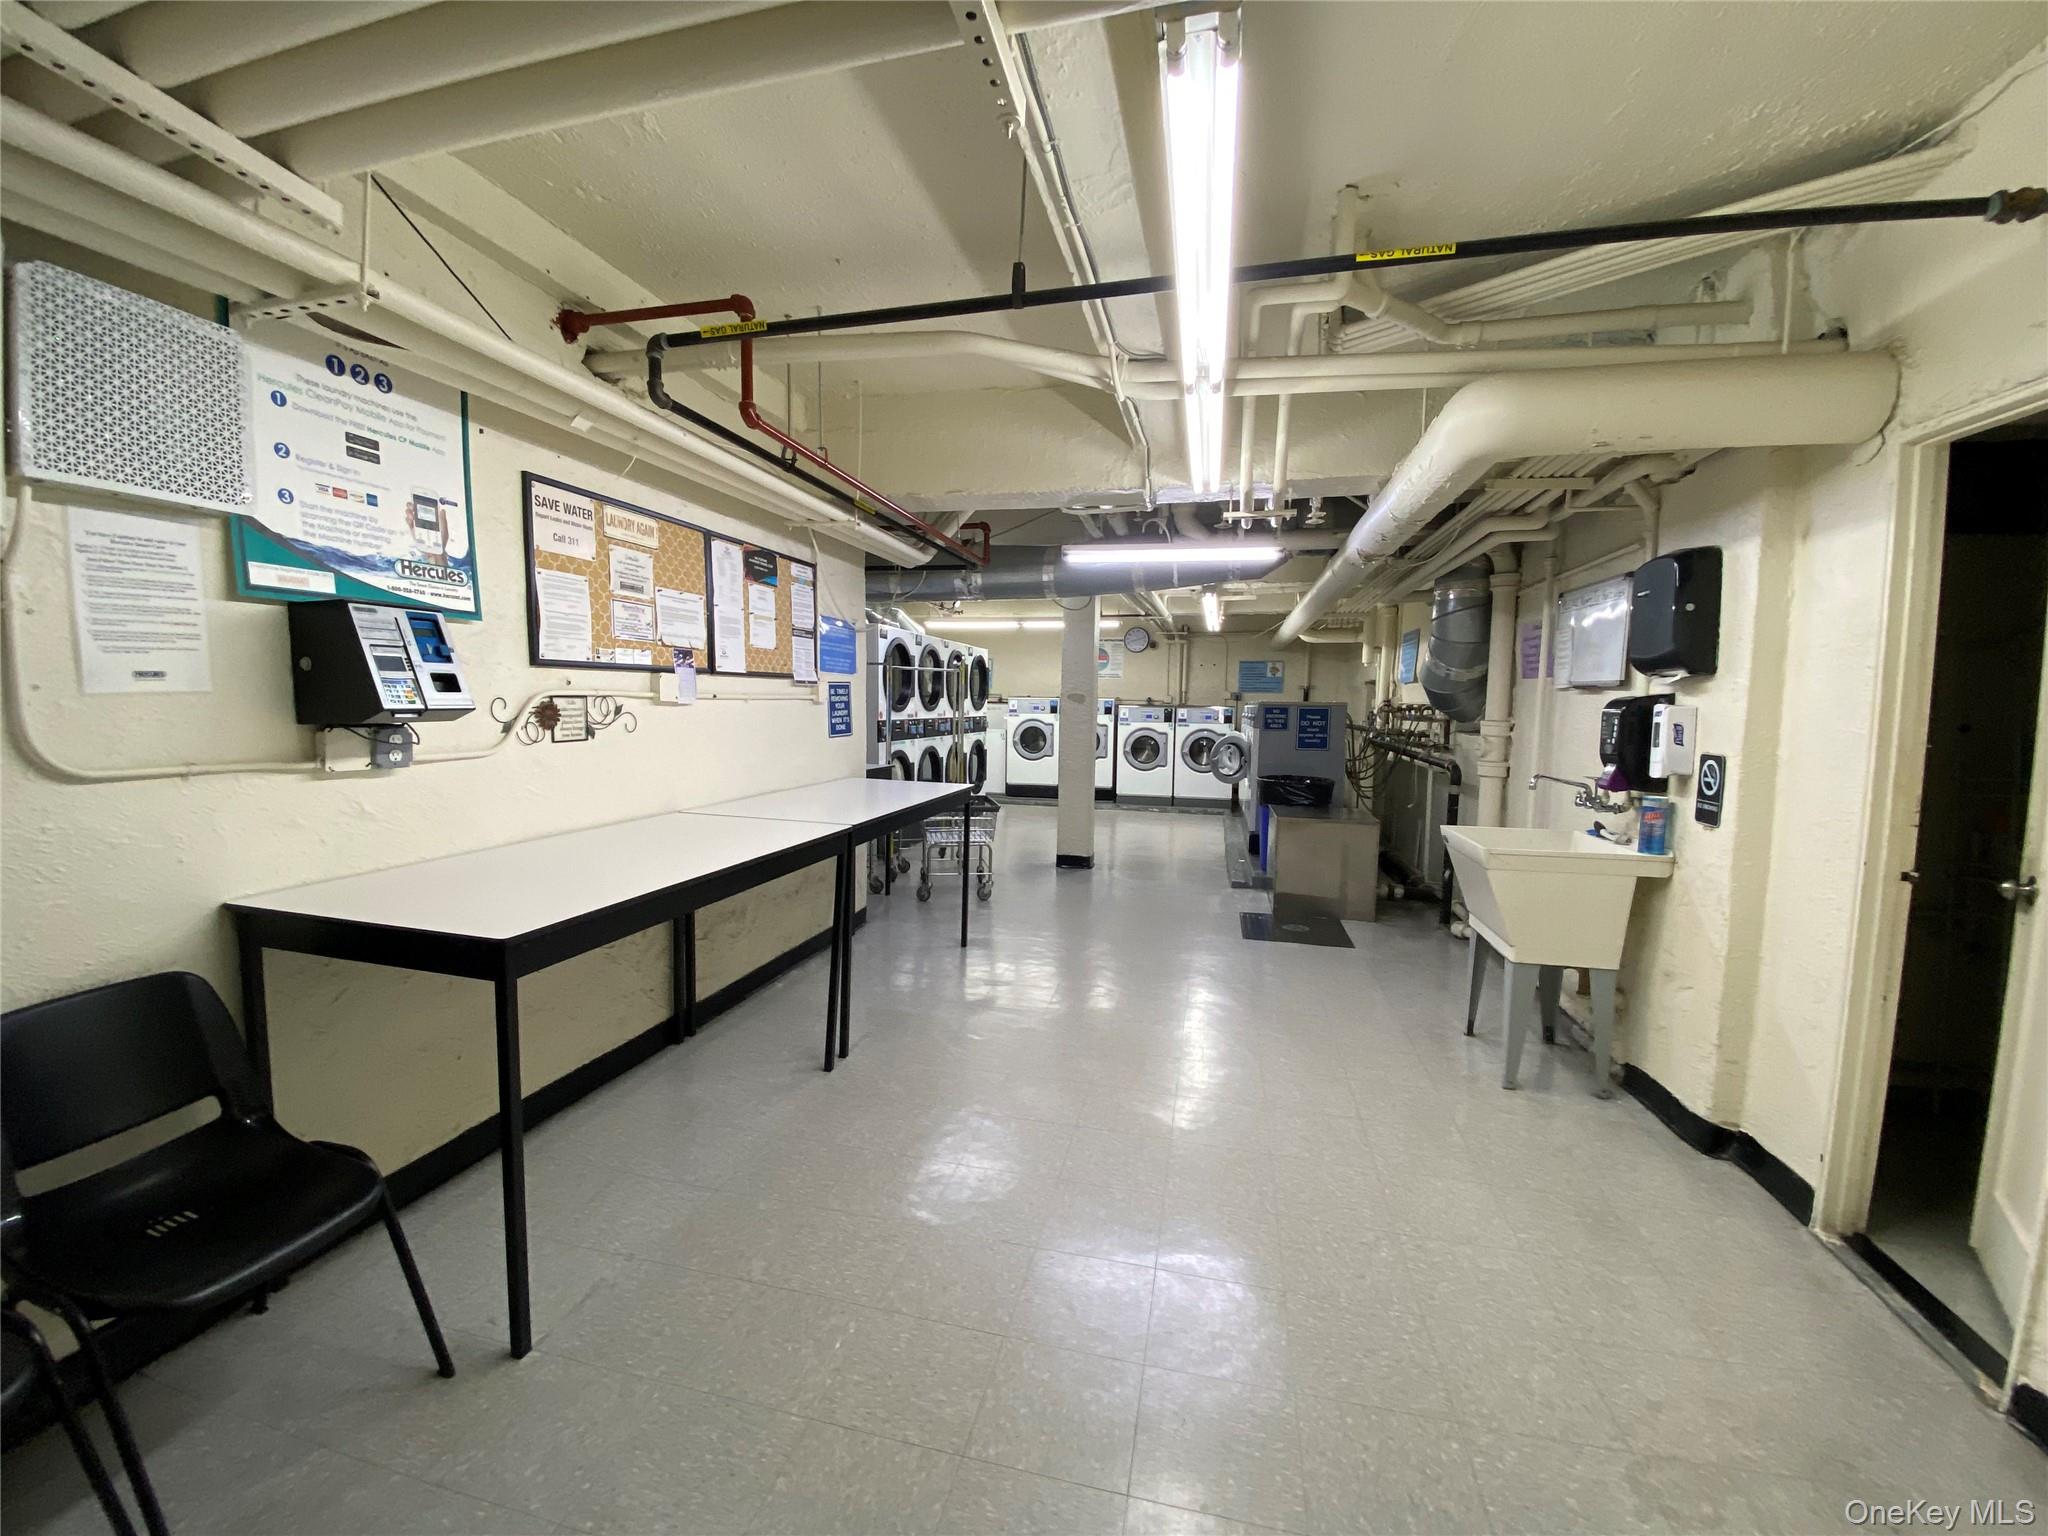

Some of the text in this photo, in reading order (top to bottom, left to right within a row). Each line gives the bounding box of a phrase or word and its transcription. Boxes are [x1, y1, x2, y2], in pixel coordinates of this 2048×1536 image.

[1370, 243, 1453, 259] NATURAL GAS
[710, 320, 766, 335] NATURAL GAS
[257, 372, 303, 395] Hercules
[355, 406, 386, 422] Mobile
[366, 425, 397, 441] Hercules
[408, 439, 430, 451] Mobile
[534, 494, 593, 521] SAVE WATER
[605, 511, 656, 539] LAUNDRY AGAIN
[552, 532, 579, 546] Call 311
[401, 559, 465, 584] Hercules
